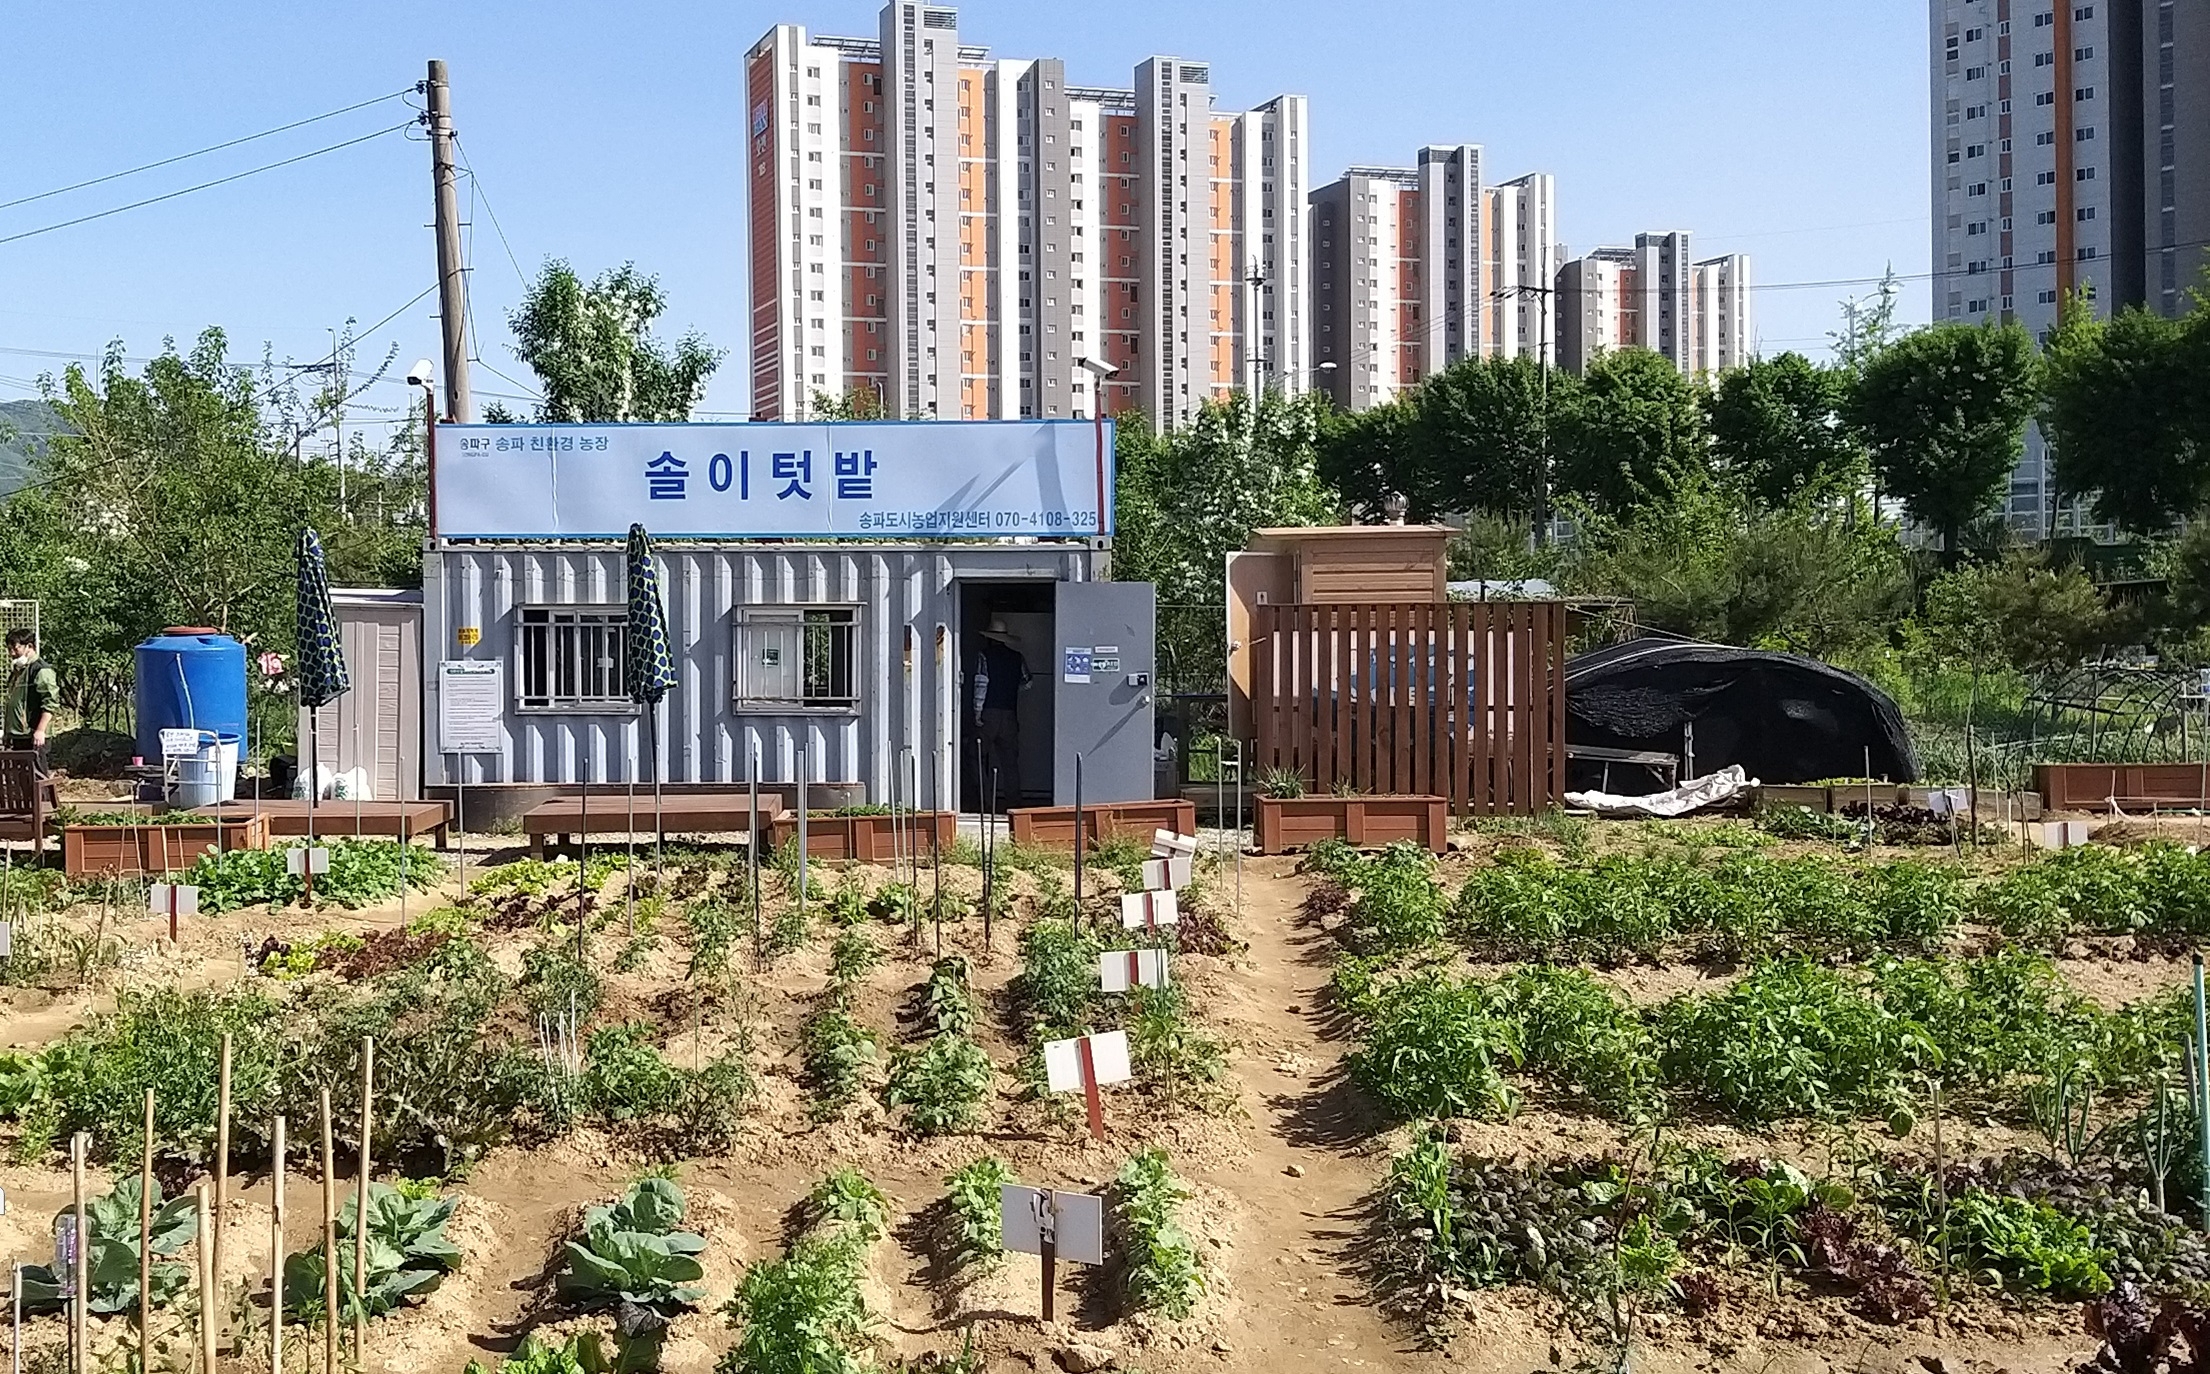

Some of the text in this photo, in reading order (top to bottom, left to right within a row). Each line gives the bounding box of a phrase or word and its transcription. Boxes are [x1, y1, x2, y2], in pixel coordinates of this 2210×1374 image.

[460, 436, 609, 451] 송파구 송파 친환경 농장
[645, 450, 878, 500] 솔이텃밭
[859, 510, 1103, 529] 송파도시농업지원센터 070-4108-325
